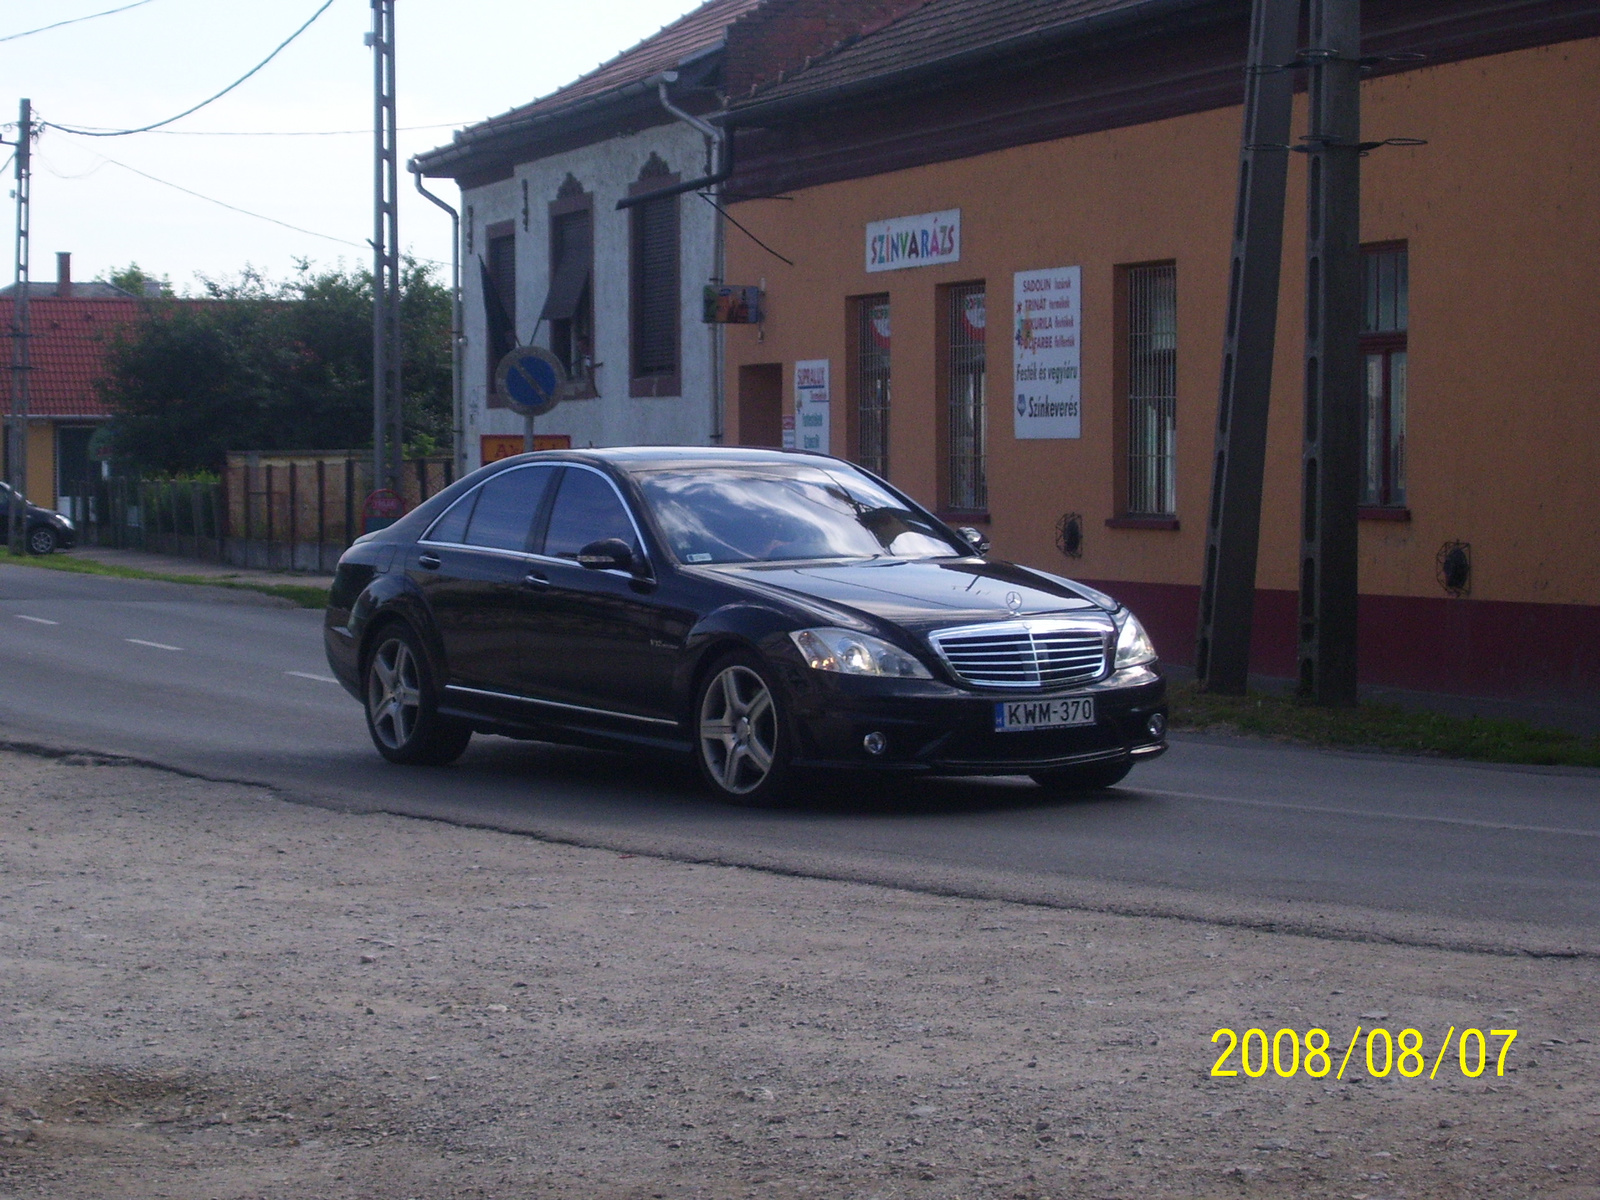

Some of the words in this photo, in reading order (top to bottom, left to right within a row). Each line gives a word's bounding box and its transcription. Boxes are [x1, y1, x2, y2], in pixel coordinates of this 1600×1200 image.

[871, 217, 954, 264] SZÍNVARÁZS
[1023, 278, 1051, 292] SADOLIN
[1016, 362, 1037, 381] Festék
[1039, 362, 1046, 379] és
[1029, 395, 1077, 417] Színkeverés
[1008, 700, 1092, 724] KWM-370
